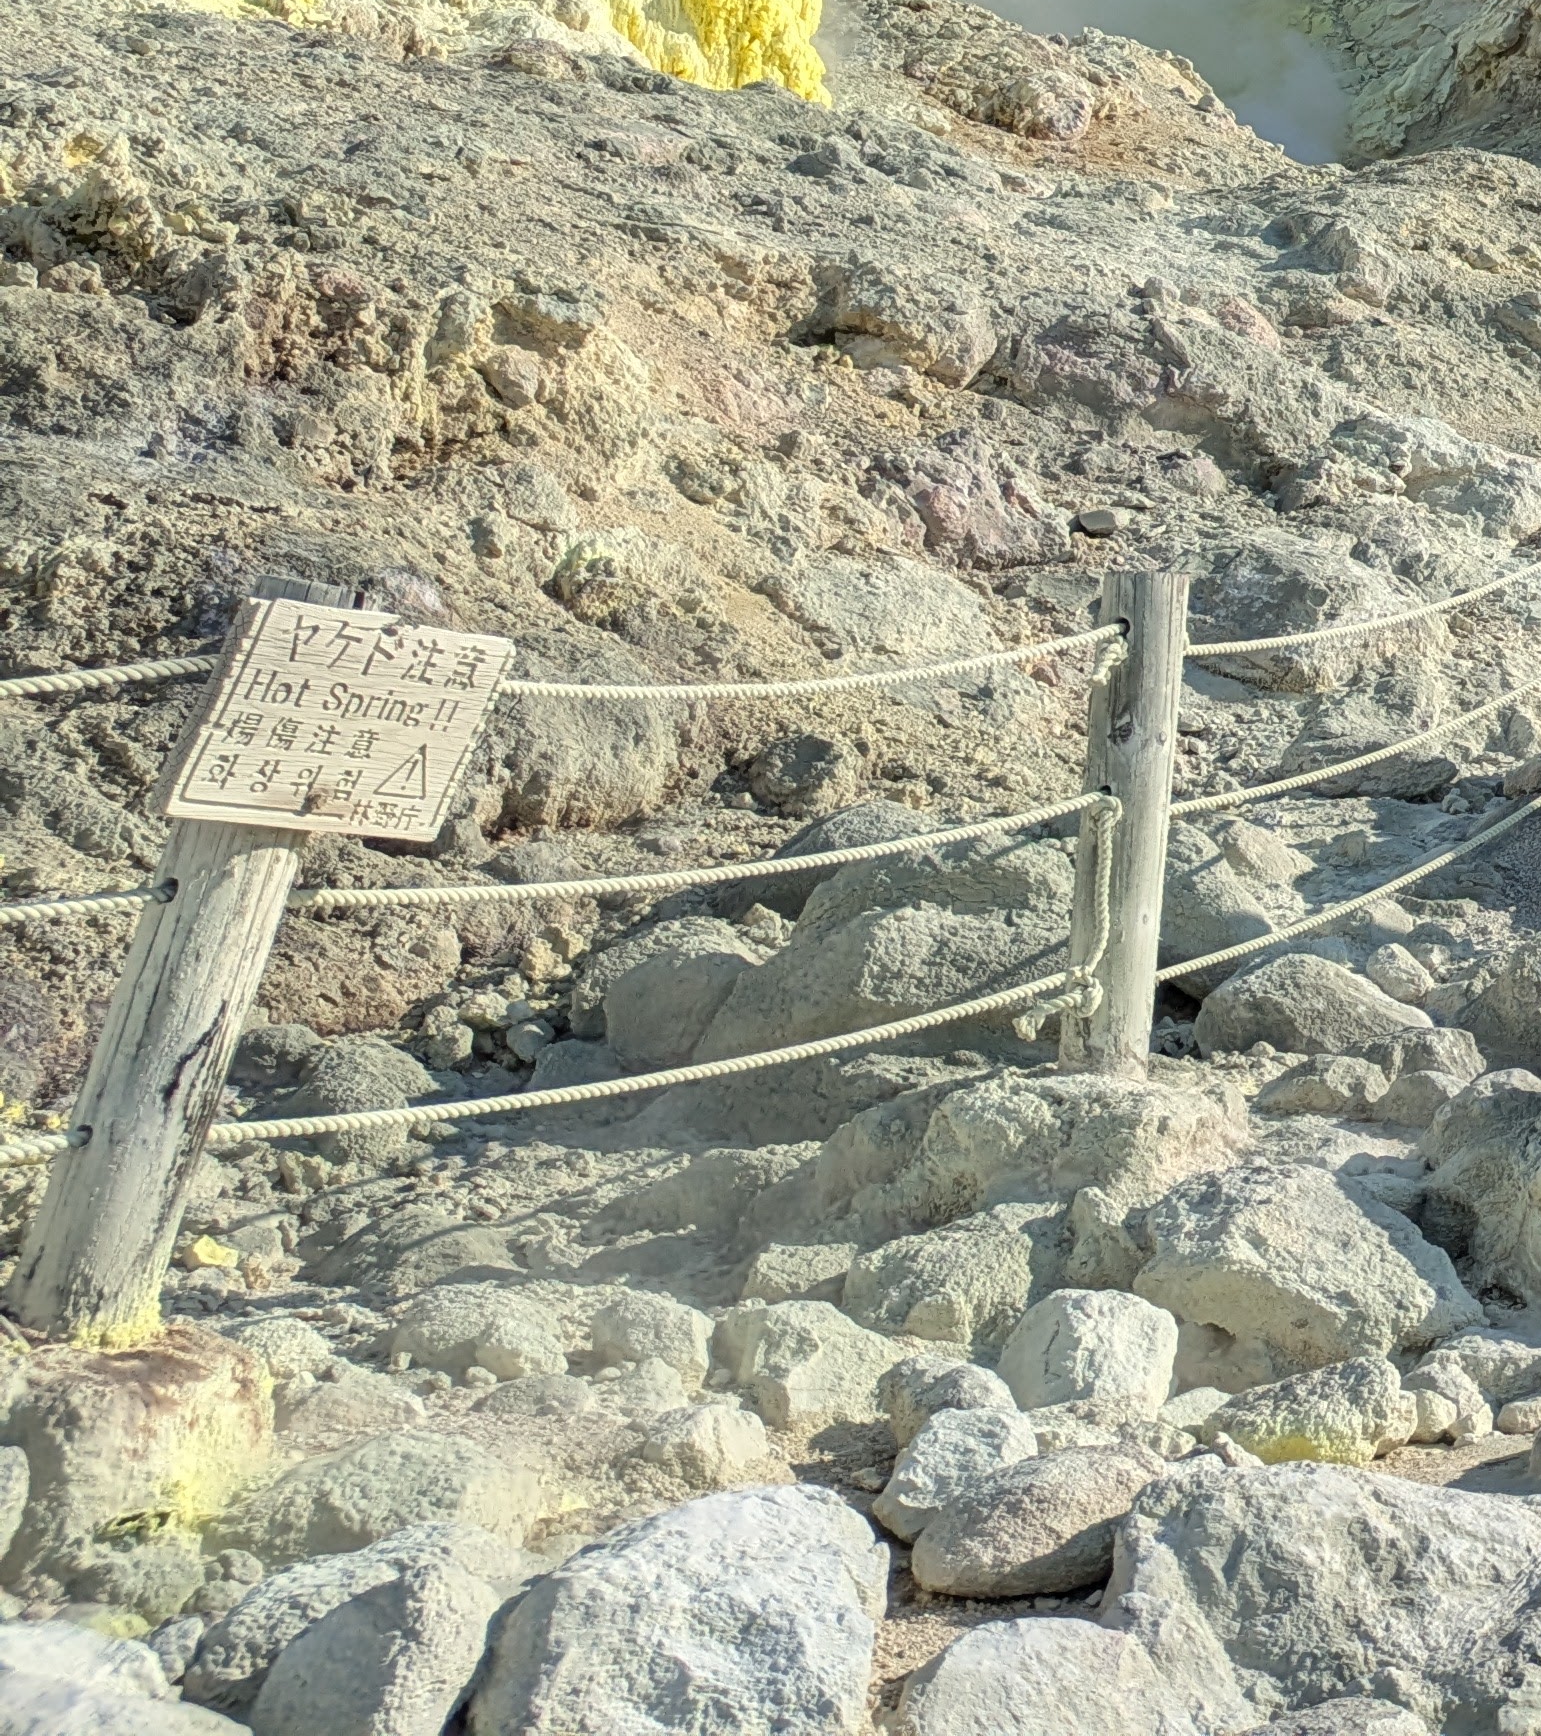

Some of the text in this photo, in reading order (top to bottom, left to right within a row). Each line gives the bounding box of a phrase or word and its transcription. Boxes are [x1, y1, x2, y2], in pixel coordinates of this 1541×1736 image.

[282, 614, 487, 691] ヤケド注意
[243, 668, 312, 708] Hot
[349, 799, 423, 831] 林野庁
